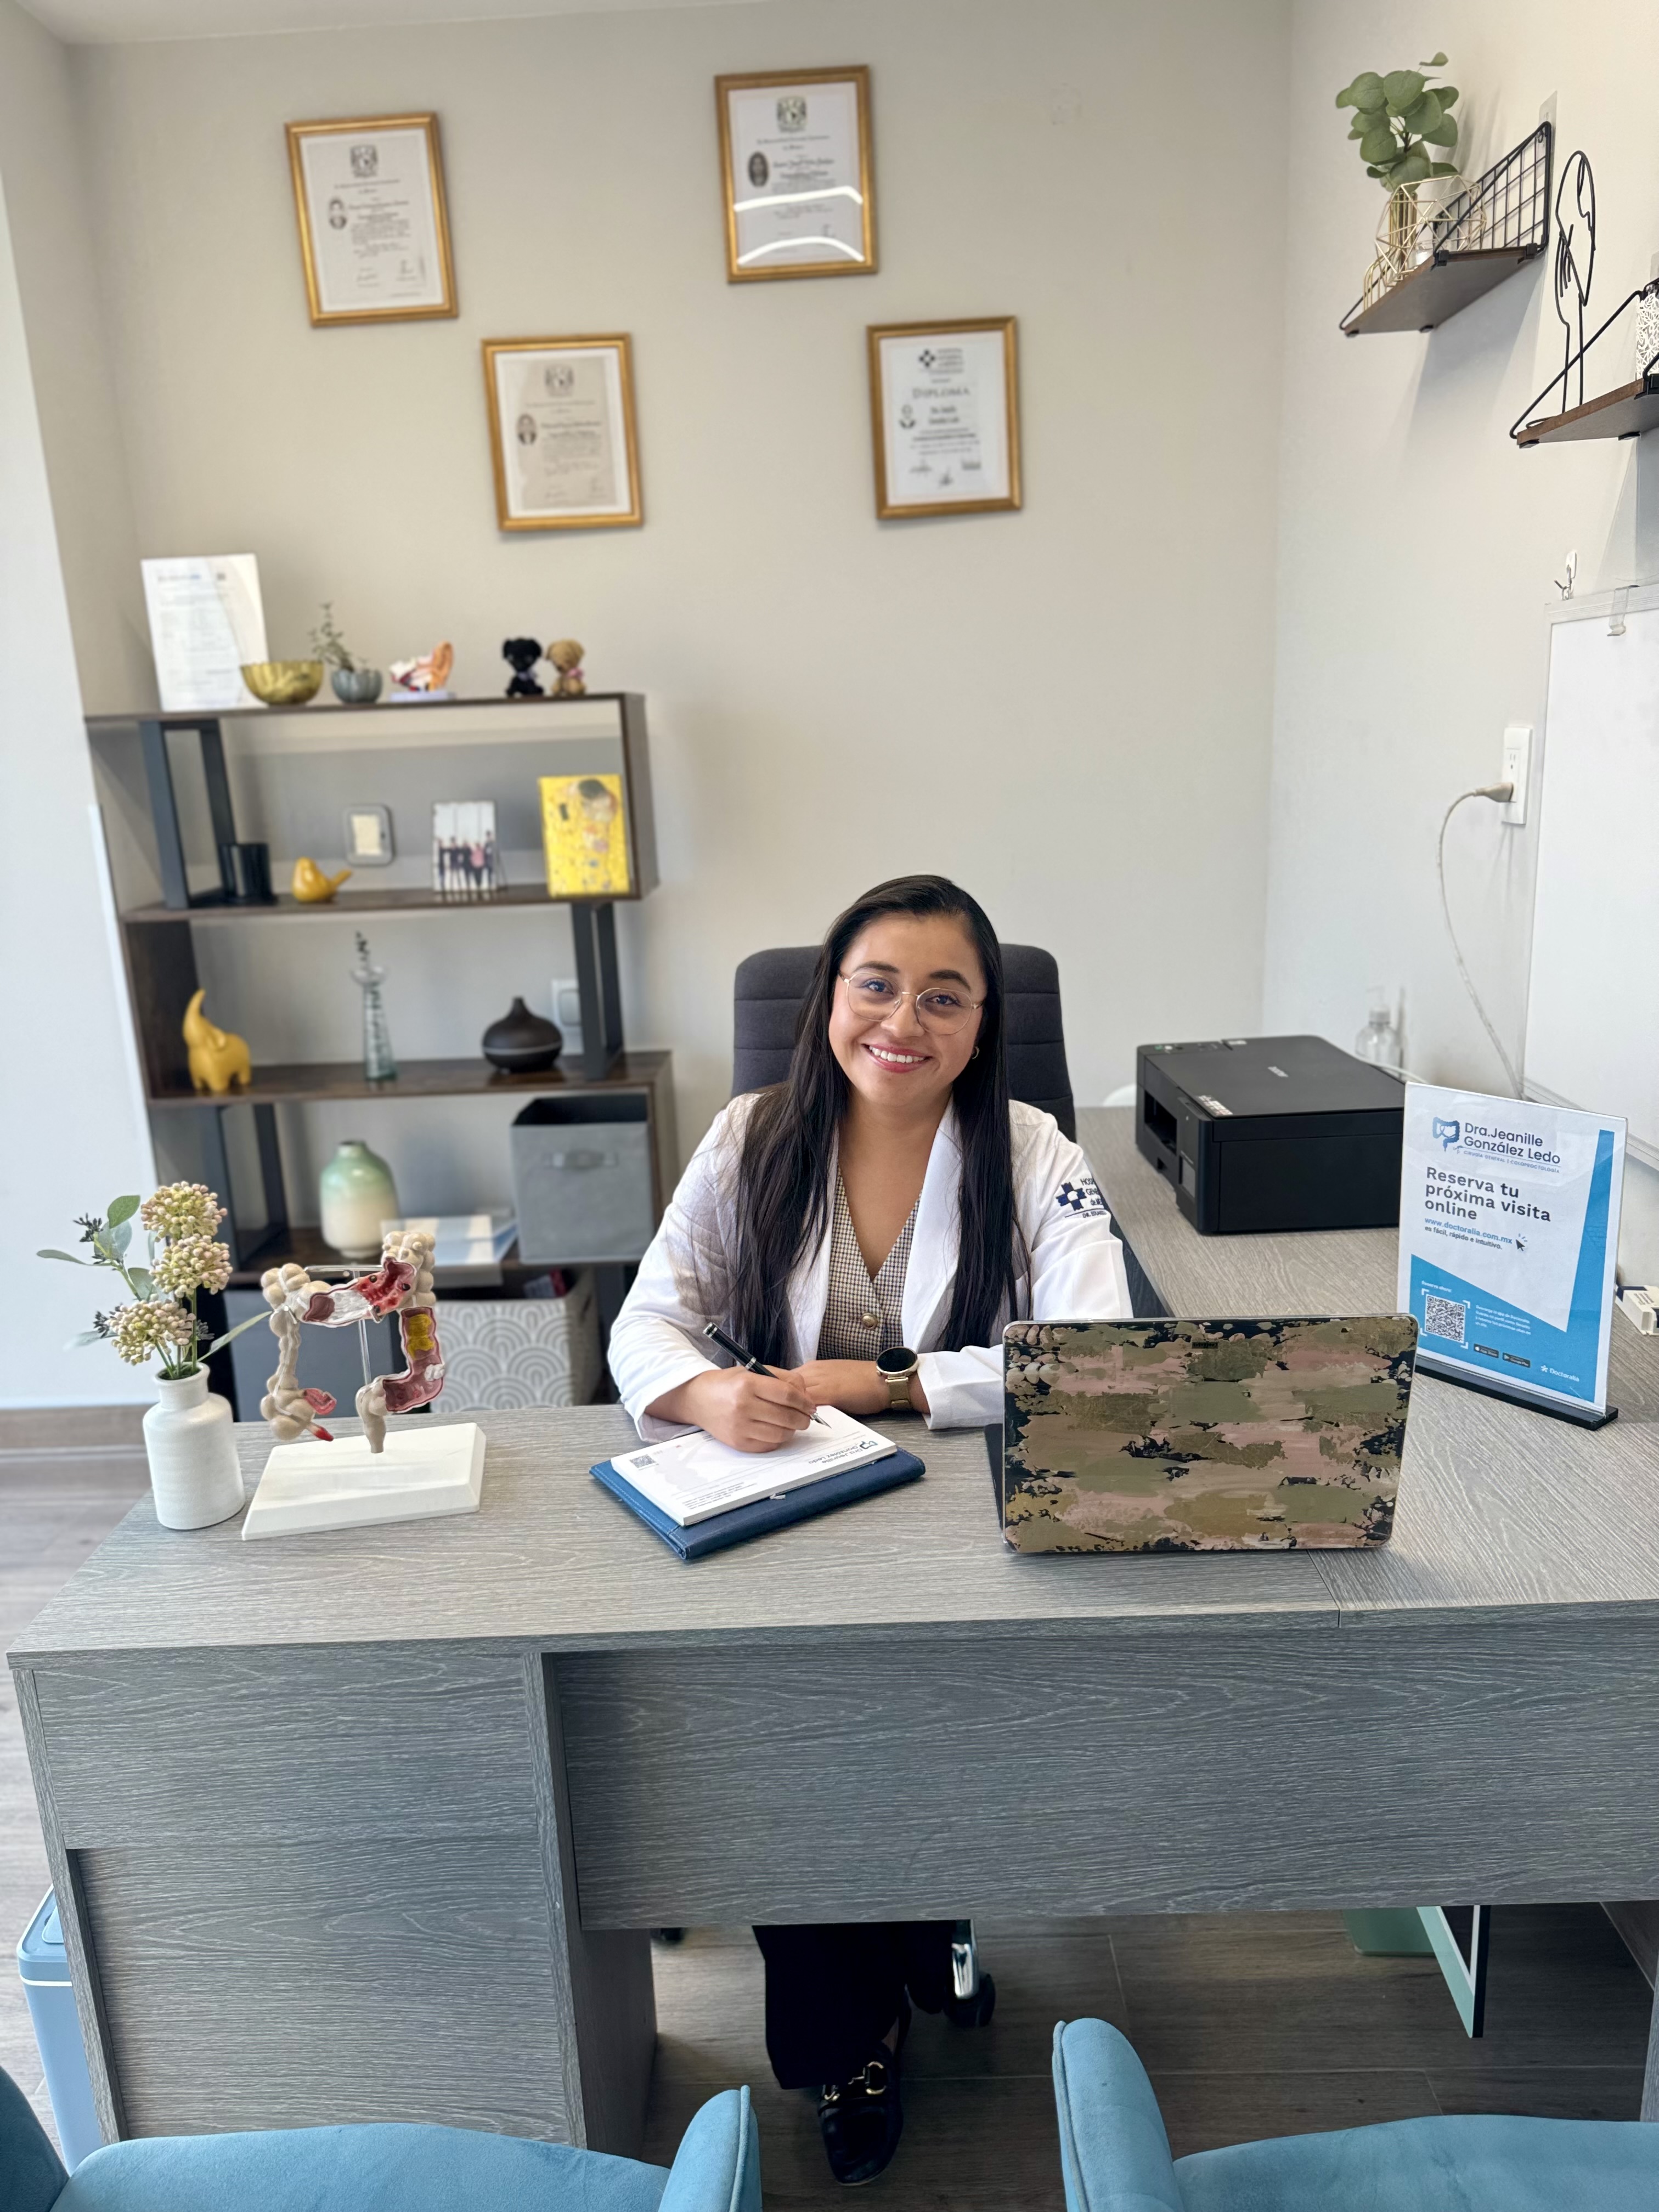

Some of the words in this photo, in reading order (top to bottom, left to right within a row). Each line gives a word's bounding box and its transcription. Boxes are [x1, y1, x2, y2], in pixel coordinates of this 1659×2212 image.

[1464, 1136, 1524, 1157] González
[1528, 1148, 1561, 1164] Ledo
[1426, 1166, 1494, 1193] Reserva
[1500, 1183, 1519, 1198] tu
[1425, 1184, 1496, 1209] próxima
[1501, 1200, 1551, 1222] visita
[1425, 1200, 1477, 1220] online
[1425, 1217, 1513, 1244] www.doctoralia.com.mx
[1433, 1227, 1448, 1237] fácil,
[1449, 1232, 1469, 1241] rápido
[1475, 1238, 1502, 1250] intuitivo.
